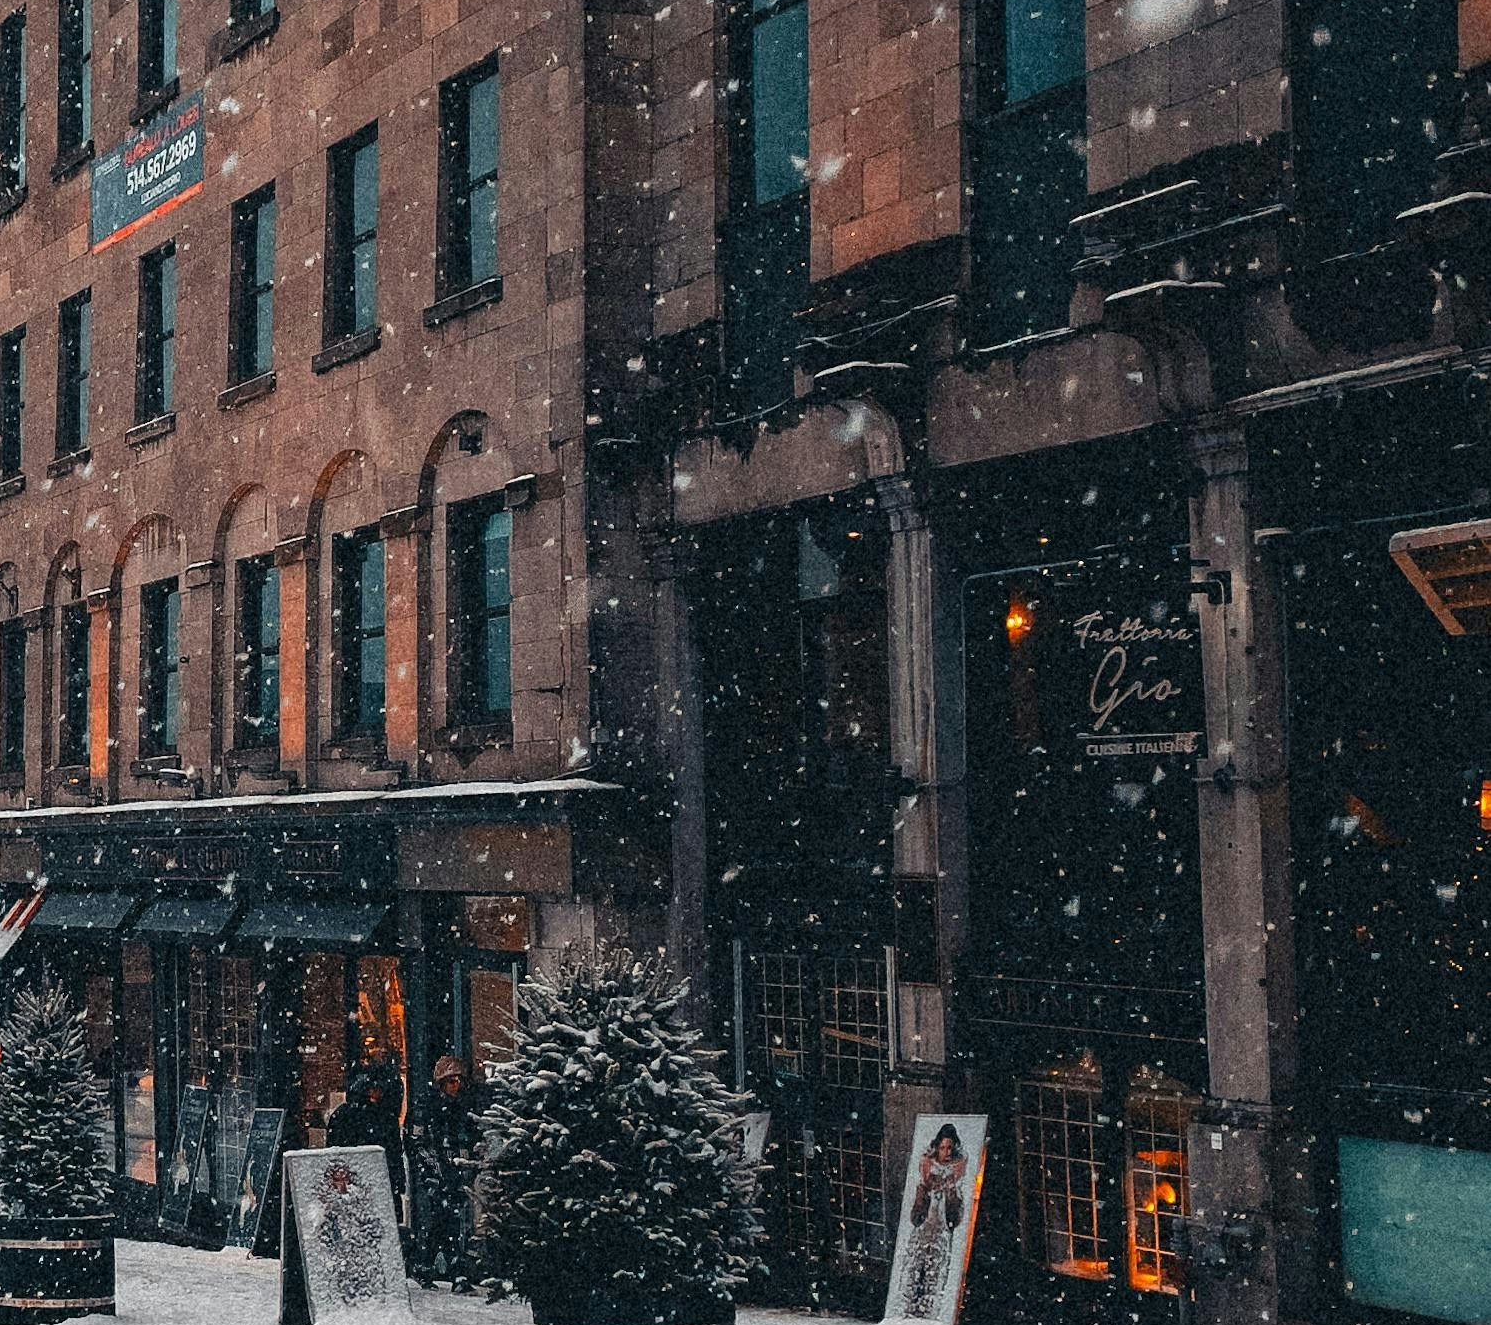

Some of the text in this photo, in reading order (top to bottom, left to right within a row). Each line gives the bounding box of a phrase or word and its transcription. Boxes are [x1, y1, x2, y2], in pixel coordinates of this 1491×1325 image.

[126, 130, 197, 195] 514.567.2969
[1073, 610, 1194, 649] Trattoria
[1089, 646, 1182, 731] Gio
